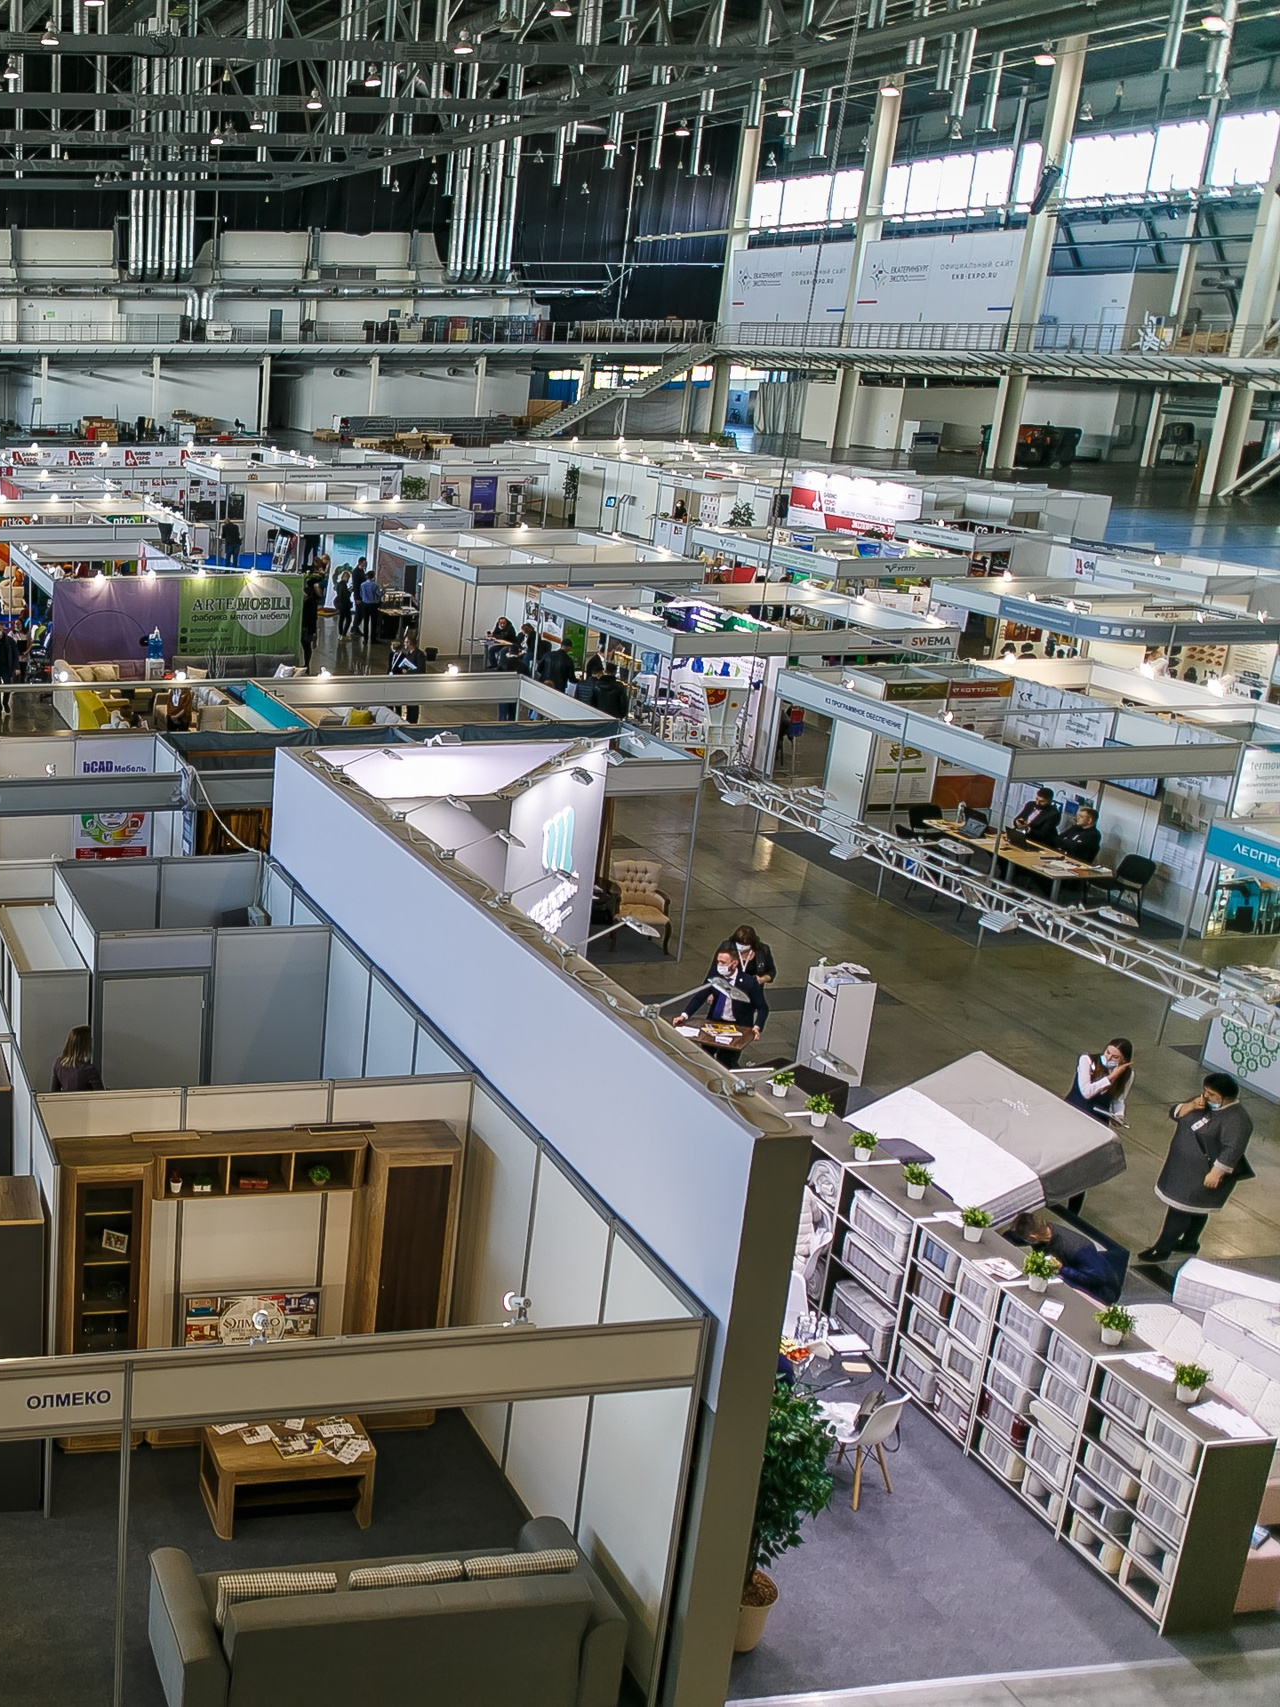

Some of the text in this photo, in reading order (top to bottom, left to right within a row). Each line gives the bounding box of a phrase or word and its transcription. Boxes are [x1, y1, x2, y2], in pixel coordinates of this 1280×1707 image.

[890, 264, 930, 274] ЕКАТЕРИНБУРГ
[939, 259, 1014, 271] ОФИЦИАЛЬНЫЙ САЙТ
[889, 274, 908, 283] ЭКСПО
[951, 271, 998, 280] EKB-EXPO.RU
[192, 597, 292, 612] ARTEMOBILI
[191, 611, 290, 623] фабрика мягкой мебели
[910, 636, 951, 646] SWEMA
[831, 699, 865, 718] ПРОГРАММНОЕ
[865, 710, 902, 730] ОБЕСПЕЧЕНИЕ
[82, 760, 147, 774] bCAD Мебель
[222, 1318, 281, 1329] ОЛМО
[26, 1389, 112, 1410] ОЛМЕКО
